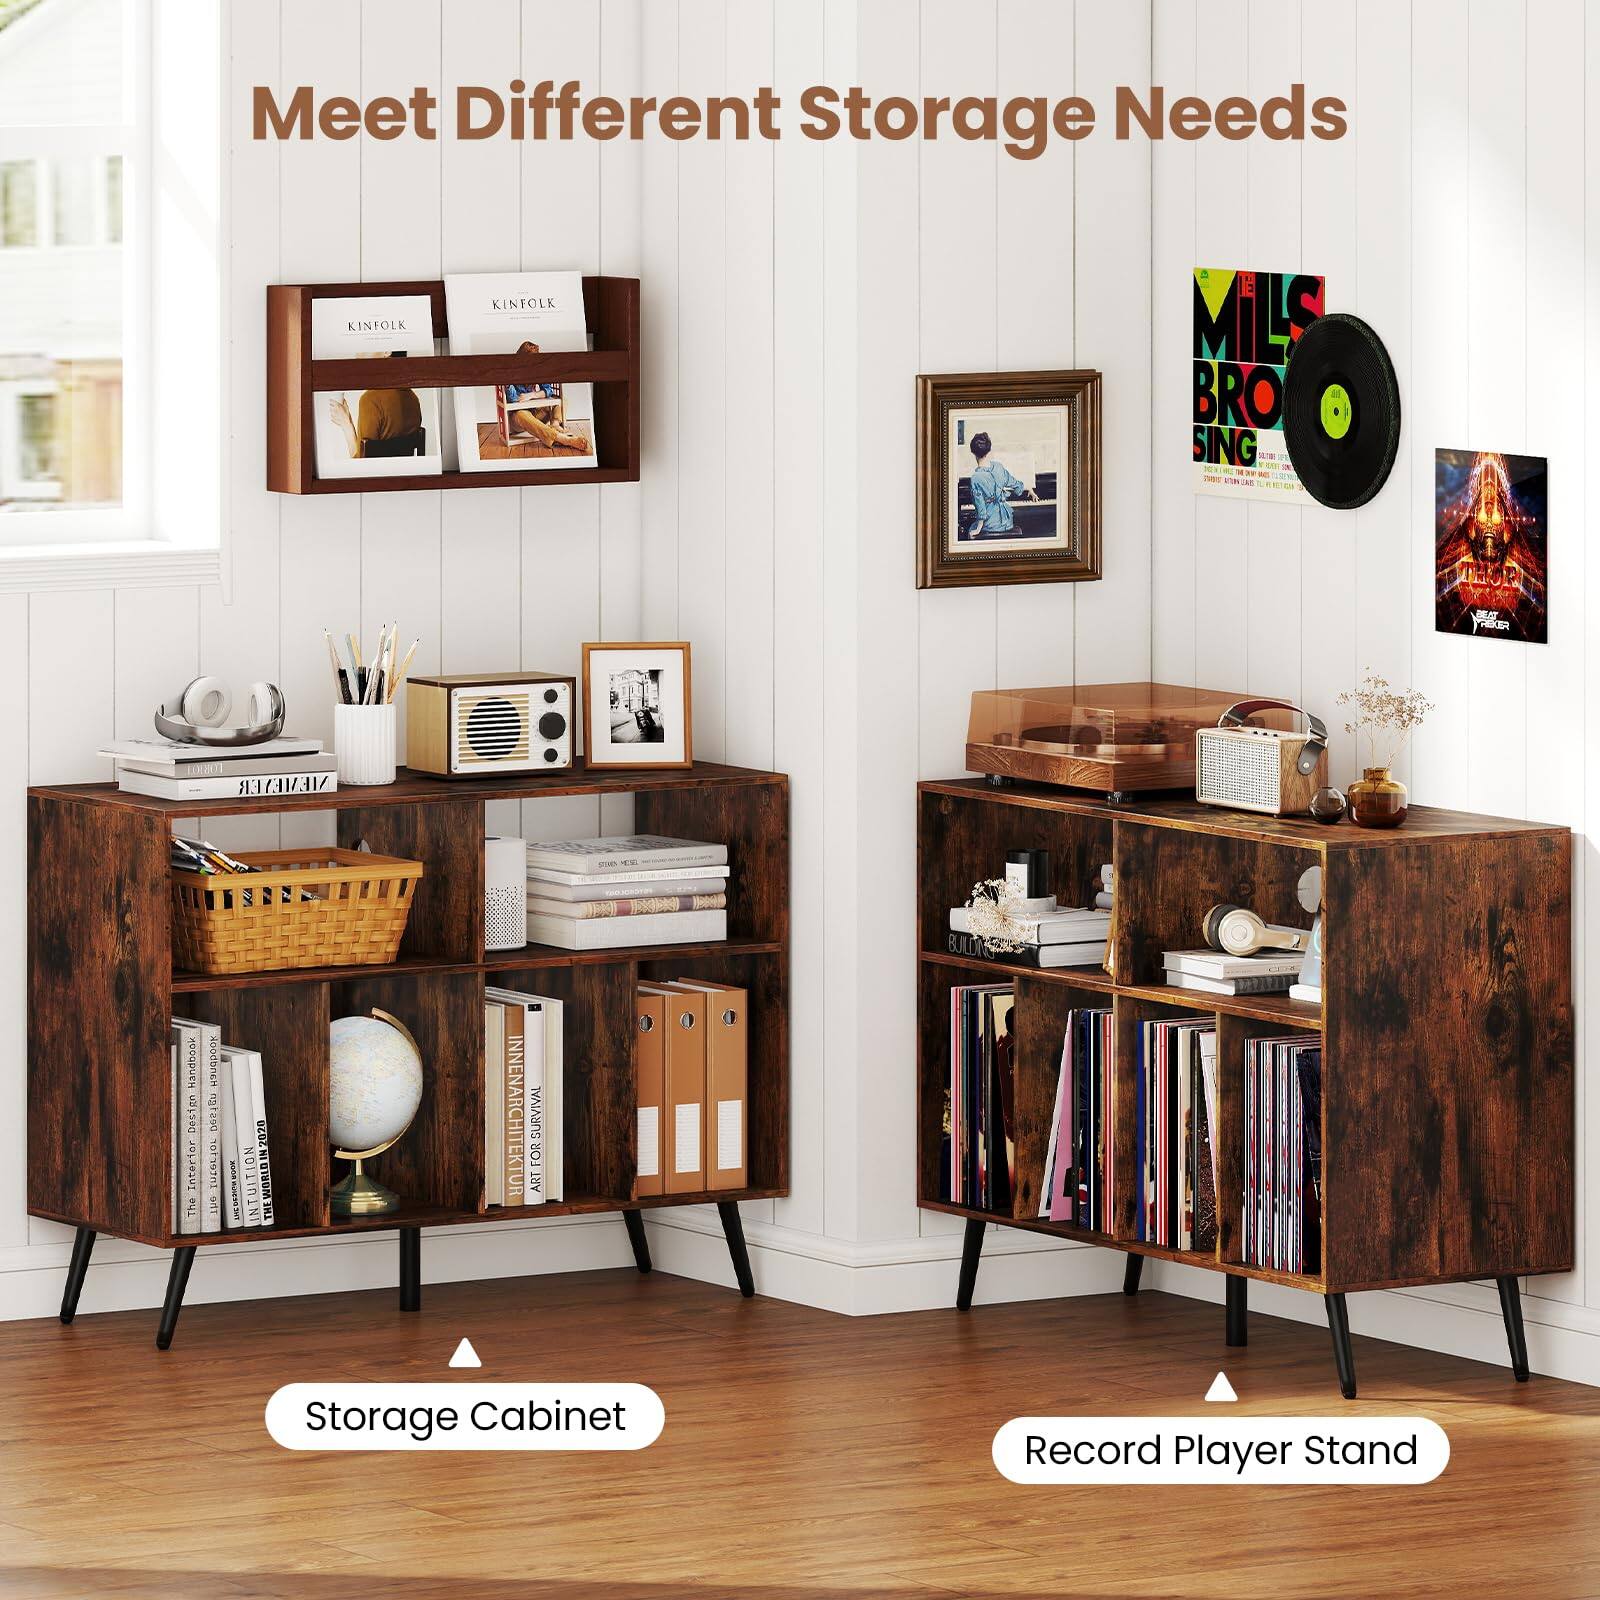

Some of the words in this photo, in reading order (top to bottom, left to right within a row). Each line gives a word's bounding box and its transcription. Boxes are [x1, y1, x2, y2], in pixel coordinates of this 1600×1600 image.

[492, 298, 556, 310] KINFOLK
[348, 320, 407, 331] KINFOLK
[1193, 425, 1257, 467] SING
[1476, 609, 1499, 620] BEAT
[187, 1037, 196, 1089] Handbook
[187, 1094, 197, 1133] Design
[508, 1034, 524, 1196] INNENARCHITEKTUR
[530, 1086, 541, 1139] SURVIVAL
[256, 1119, 268, 1147] 2020
[187, 1140, 196, 1191] Interior
[259, 1149, 268, 1160] IN
[530, 1142, 541, 1167] FOR
[244, 1146, 260, 1221] INTUITION
[260, 1162, 272, 1200] WORLD
[530, 1172, 541, 1193] ART
[187, 1197, 196, 1218] The
[263, 1200, 273, 1221] THE
